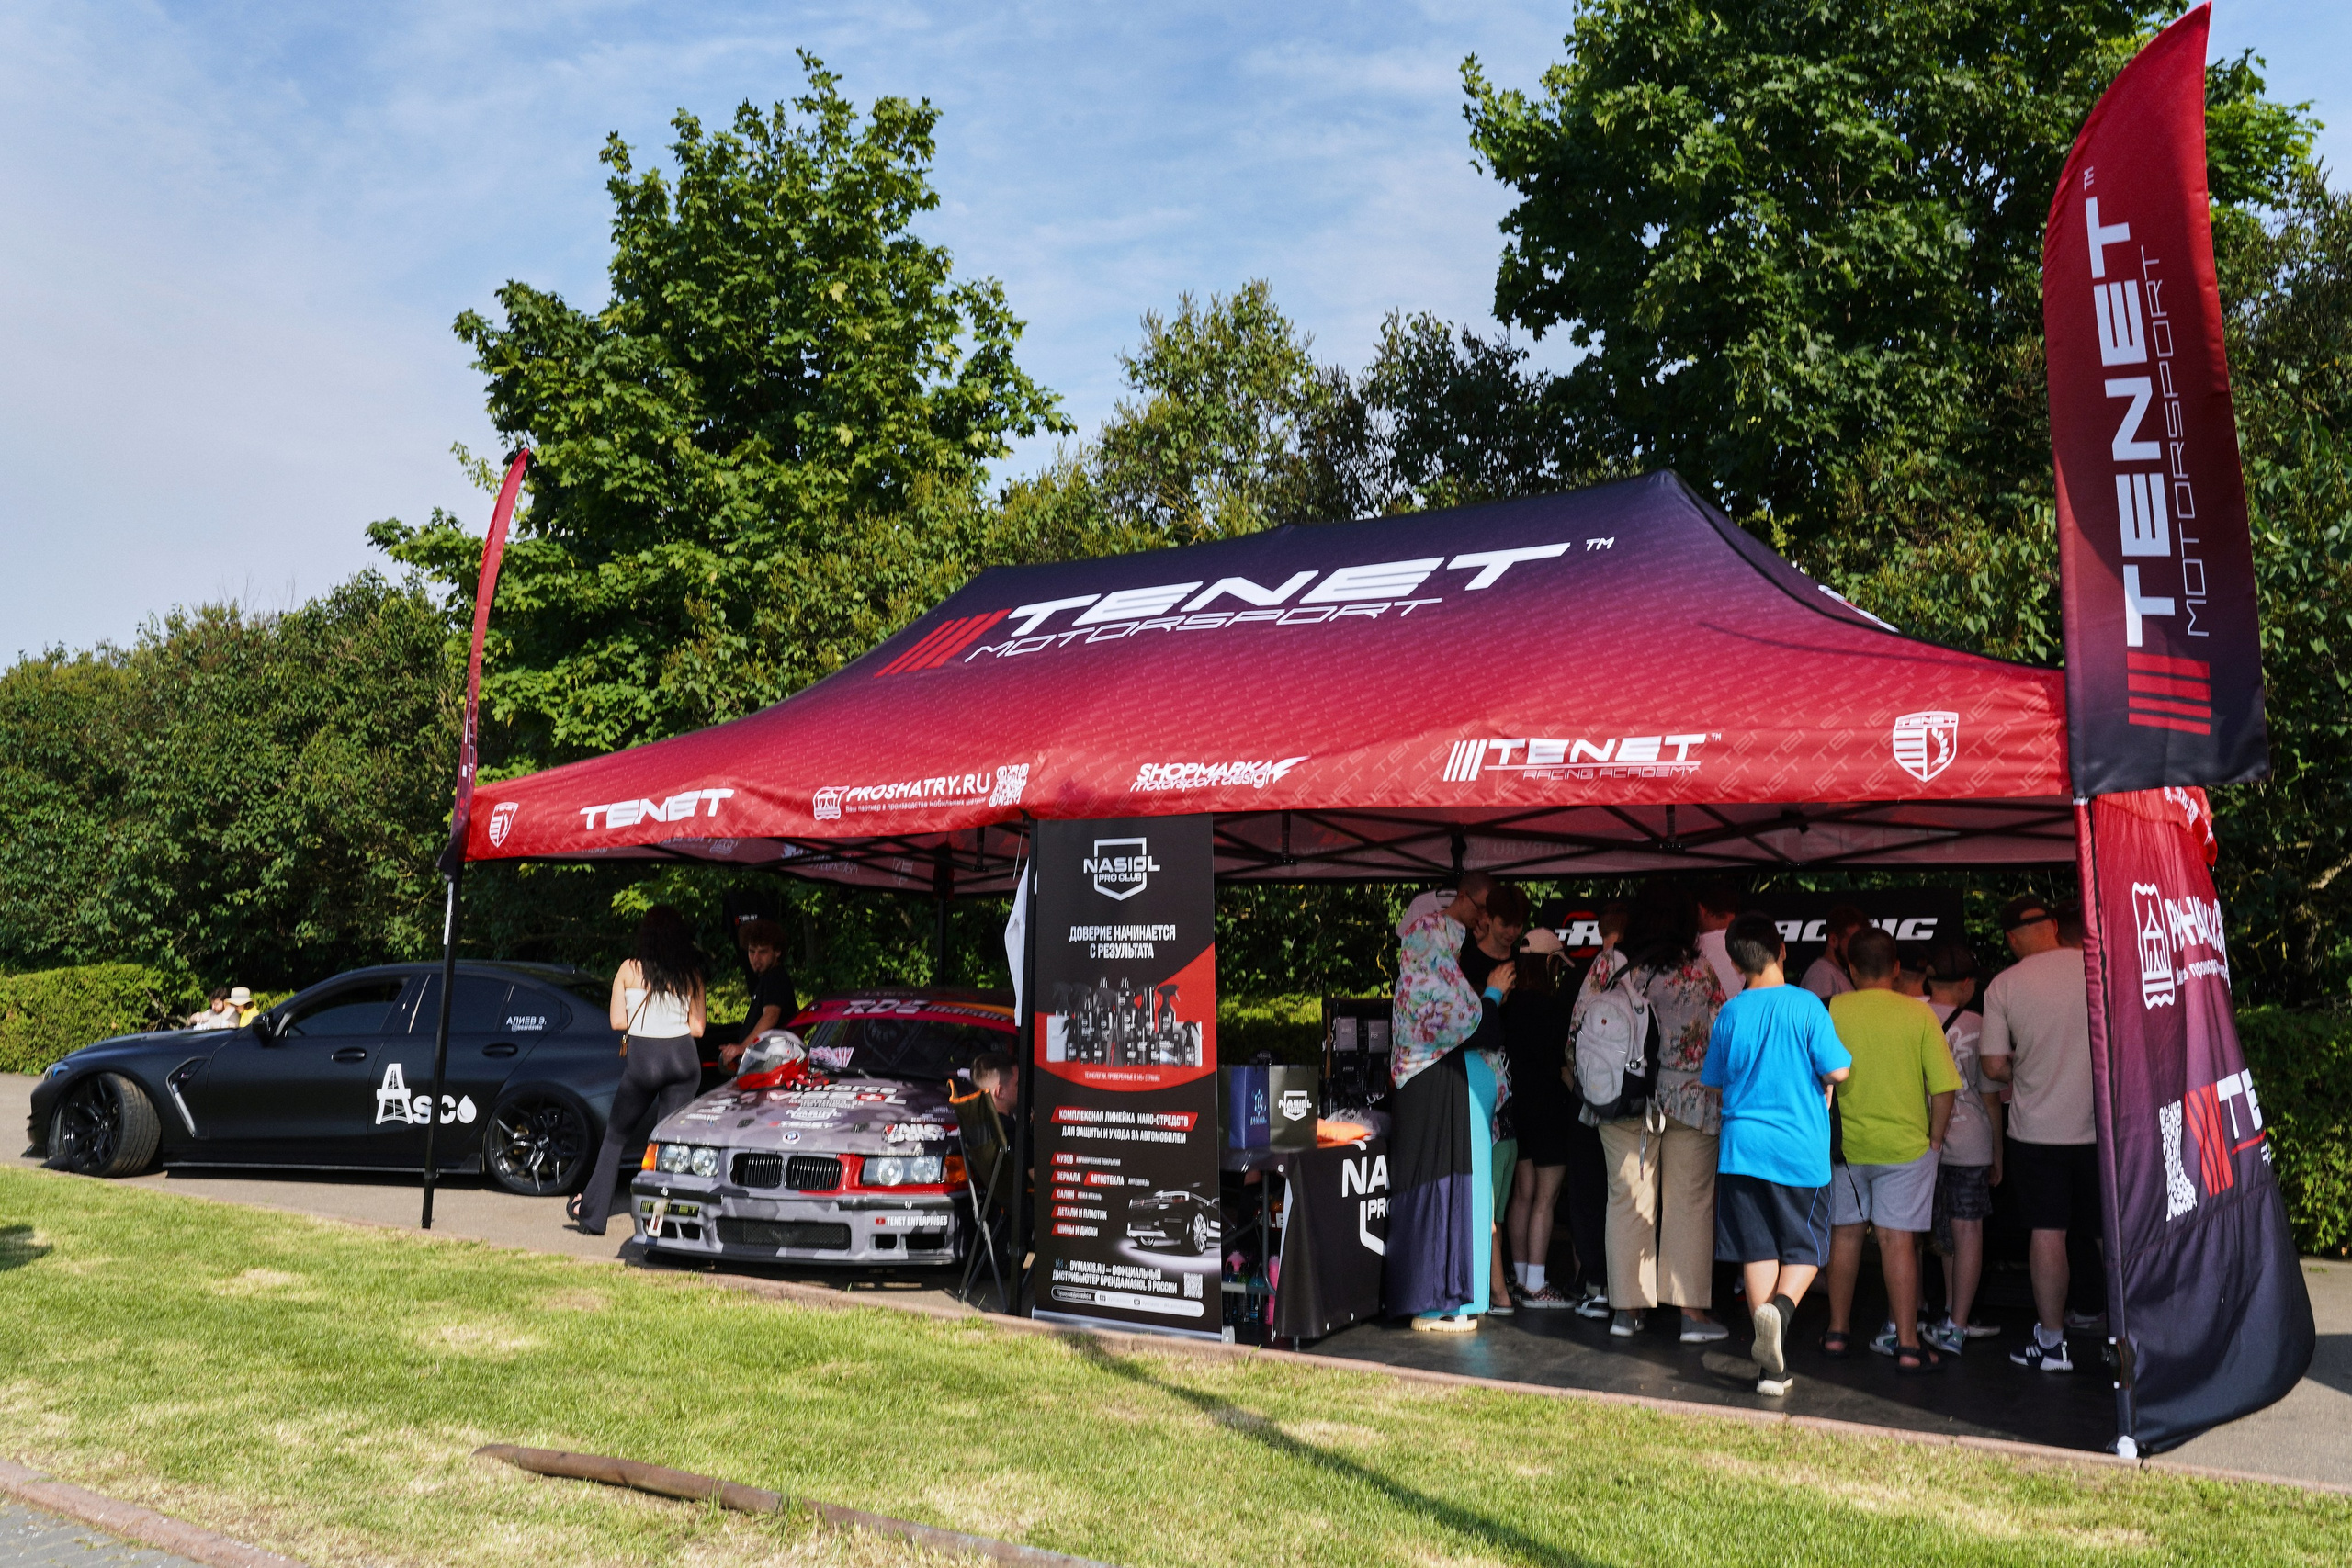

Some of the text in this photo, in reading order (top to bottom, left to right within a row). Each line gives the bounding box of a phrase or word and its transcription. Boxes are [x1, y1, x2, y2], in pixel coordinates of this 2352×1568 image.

[2085, 196, 2175, 647] TENET
[2141, 244, 2210, 637] MOTORSPORT
[1009, 542, 1570, 637] TENET
[965, 597, 1442, 662] MOTORSPORT
[1488, 733, 1706, 765] TENET
[1136, 759, 1272, 782] SHOPMARKA
[1522, 765, 1699, 780] RACING ACADEMY
[846, 773, 991, 802] PROSHATRY.RU
[580, 788, 734, 830] TENET
[1083, 855, 1160, 874] NASIOL
[1099, 874, 1116, 883] PRO
[1069, 924, 1176, 942] ДОВЕРИЕ НАЧИНАЕТСЯ
[1090, 942, 1155, 959] С РЕЗУЛЬТАТА
[1059, 1109, 1103, 1122] КОМПЛЕКСНАЯ
[1104, 1110, 1136, 1124] ЛИНЕЙКА
[1062, 1125, 1186, 1144] ДЛЯ ЗАЩИТЫ И УХОДА ЗА АВТОМОБИЛЕМ
[1057, 1154, 1074, 1165] КУЗОВ
[1057, 1171, 1080, 1182] ЗЕРКАЛА
[1091, 1173, 1125, 1186] АВТОСТЕКЛА
[1057, 1189, 1075, 1200] САЛОН
[887, 1215, 948, 1226] TENET ENTERPRISES
[1057, 1206, 1078, 1218] ДЕТАЛИ
[1083, 1208, 1107, 1220] ПЛАСТИК
[1112, 1265, 1161, 1280] ОФИЦИАЛЬНЫЙ
[1101, 1276, 1125, 1289] БРЕНДА
[1152, 1281, 1177, 1294] РОССИИ
